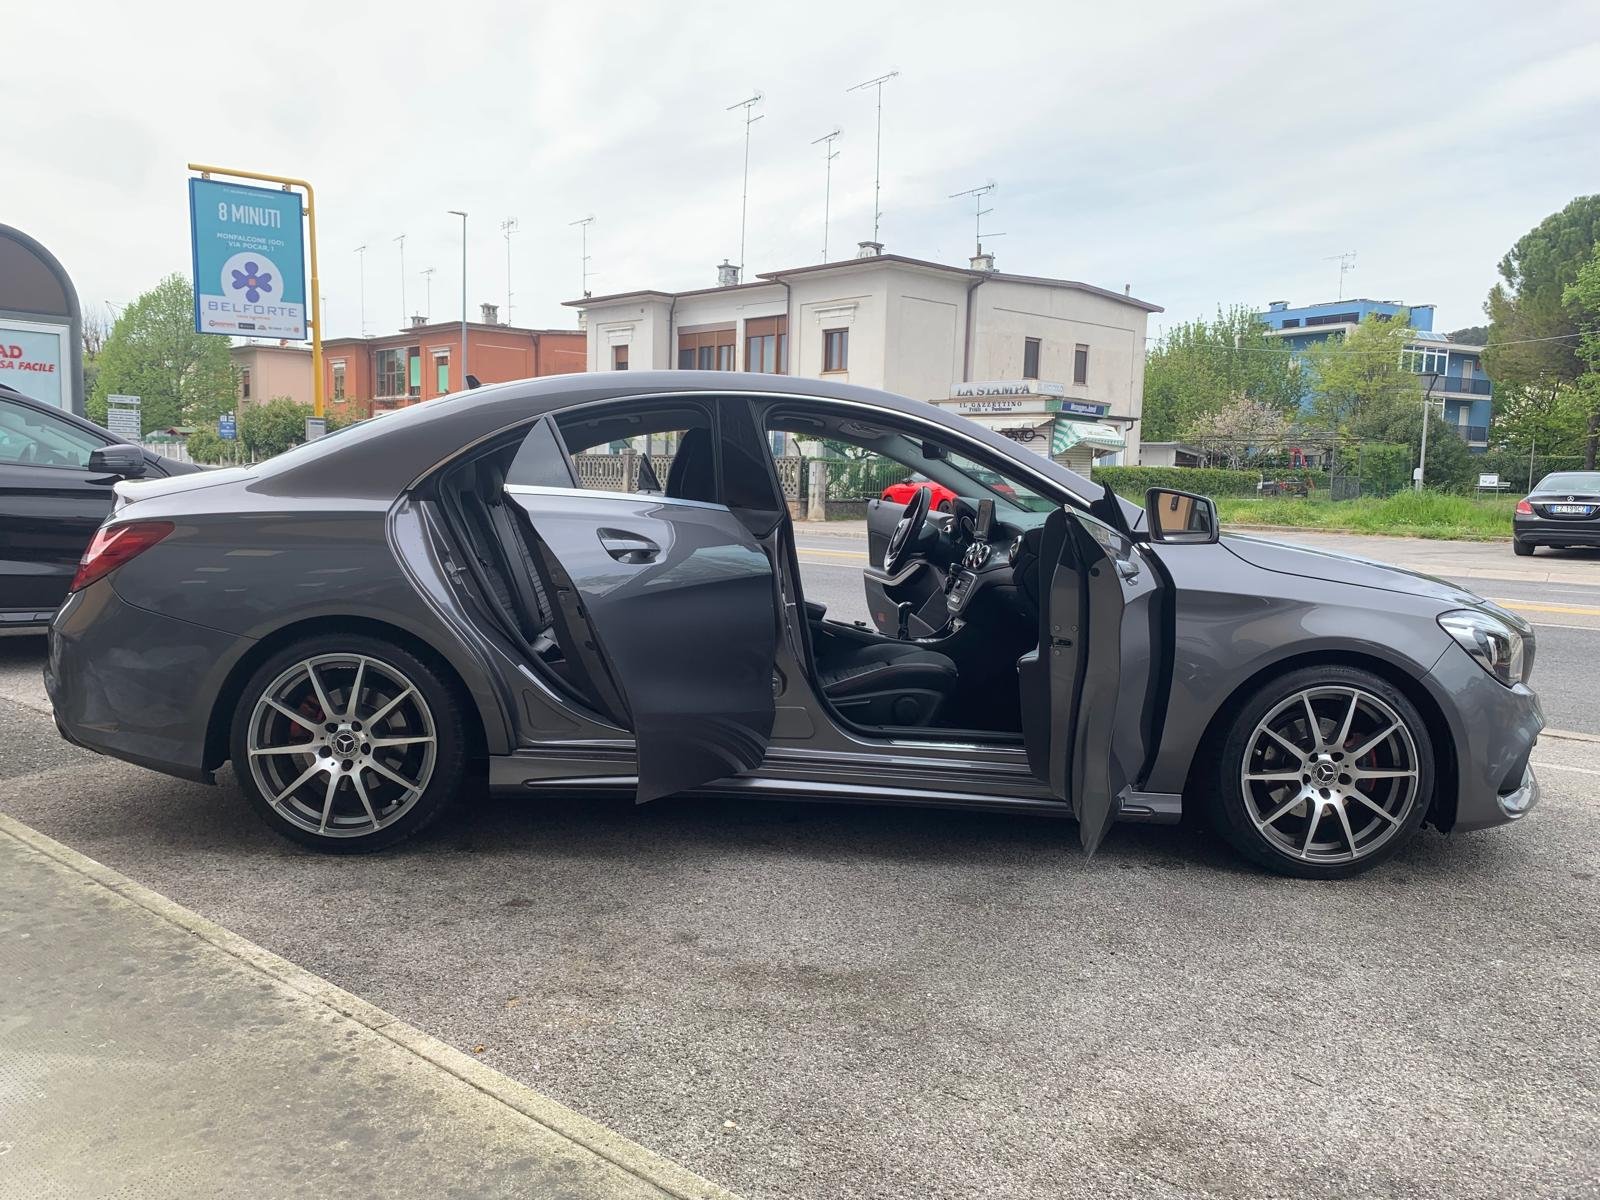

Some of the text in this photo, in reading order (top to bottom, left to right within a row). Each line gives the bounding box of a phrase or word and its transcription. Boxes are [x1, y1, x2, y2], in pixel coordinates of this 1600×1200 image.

[217, 202, 281, 229] 8 MINUTI
[208, 301, 297, 317] BELFORTE
[18, 361, 55, 373] FACILE
[957, 384, 1031, 397] LA STAMPA
